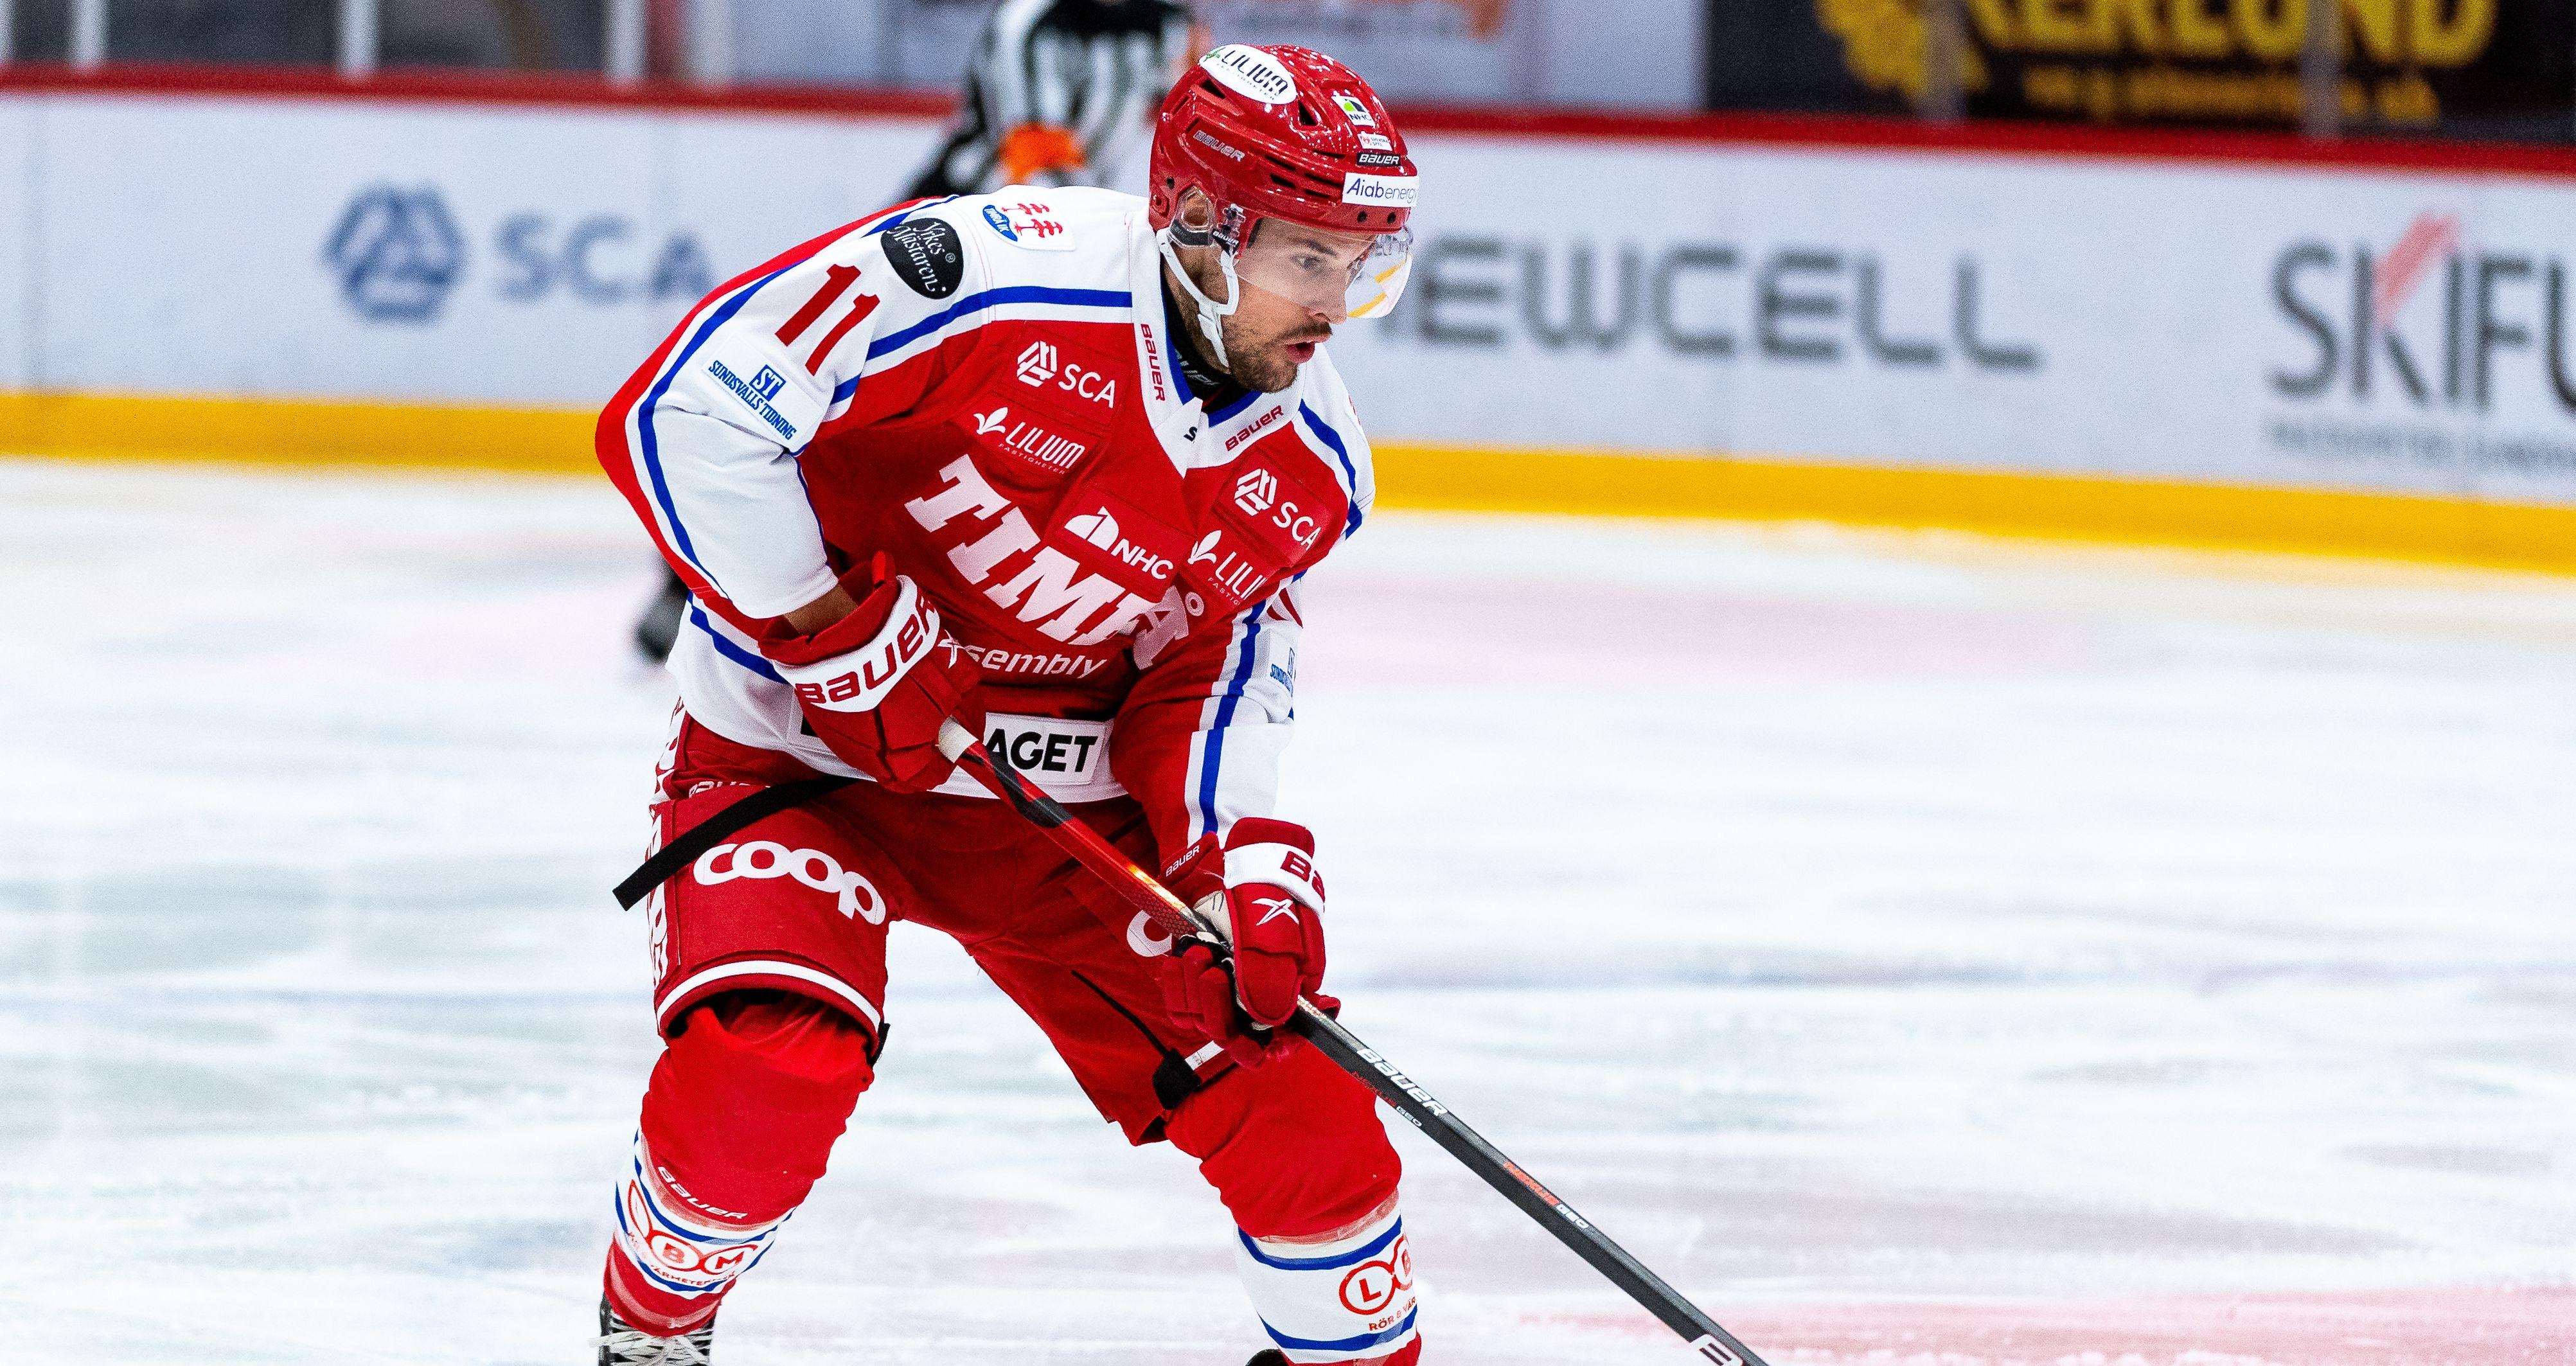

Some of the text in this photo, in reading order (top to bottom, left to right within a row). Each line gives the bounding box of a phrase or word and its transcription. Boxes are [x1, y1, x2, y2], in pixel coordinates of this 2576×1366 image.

[1193, 130, 1245, 162] BAUER
[1359, 154, 1399, 165] BAUER
[493, 211, 715, 307] SCA
[775, 264, 880, 376] 11
[753, 368, 783, 397] ST
[1058, 364, 1115, 408] SCA
[1141, 323, 1166, 402] BAUER
[708, 360, 797, 440] SUNDSVALLS TIDNING
[1005, 421, 1085, 469] LILIUM
[1225, 405, 1284, 452] BAUER
[999, 443, 1066, 475] FASTIGHETER
[1272, 502, 1322, 551] SCA
[1111, 537, 1173, 580] NHC
[1215, 551, 1268, 600] LILI
[795, 587, 936, 705] BAUER
[985, 728, 1099, 773] AGET
[693, 840, 887, 926] coop
[1165, 845, 1200, 878] BAUER
[1356, 1048, 1448, 1117] BAUER
[657, 1166, 749, 1220] BAUER
